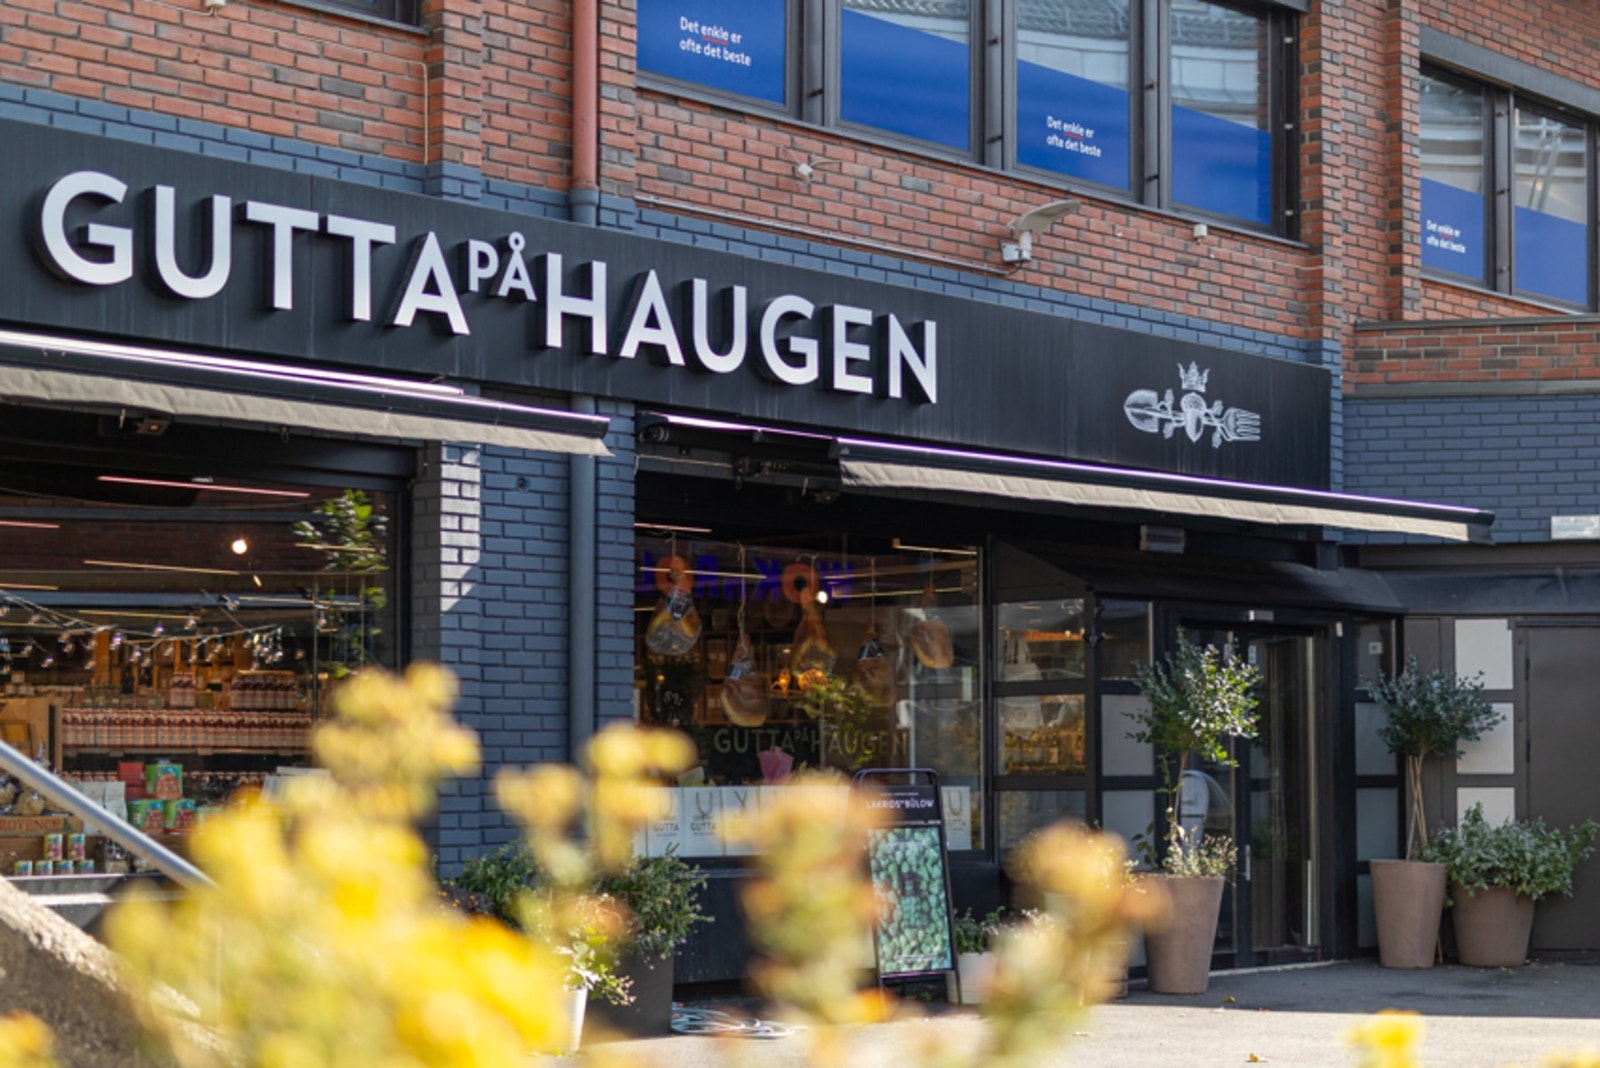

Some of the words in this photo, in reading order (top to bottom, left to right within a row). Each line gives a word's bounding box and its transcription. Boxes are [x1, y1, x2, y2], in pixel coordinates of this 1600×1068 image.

[680, 16, 698, 34] Det
[701, 25, 729, 41] enkle
[730, 32, 742, 44] er
[679, 38, 702, 54] ofte
[704, 43, 721, 59] det
[723, 47, 751, 66] beste
[1047, 115, 1062, 131] Det
[1063, 122, 1084, 136] enkle
[1086, 128, 1094, 138] er
[1046, 134, 1063, 148] ofte
[1065, 138, 1079, 152] det
[1080, 141, 1102, 157] beste
[41, 170, 470, 335] GUTTA
[468, 231, 536, 300] PÅ
[545, 252, 937, 404] HAUGEN
[713, 728, 795, 753] GUTTA
[795, 726, 810, 743] PÅ
[811, 729, 908, 756] HAUGEN
[652, 823, 680, 833] GUTTA
